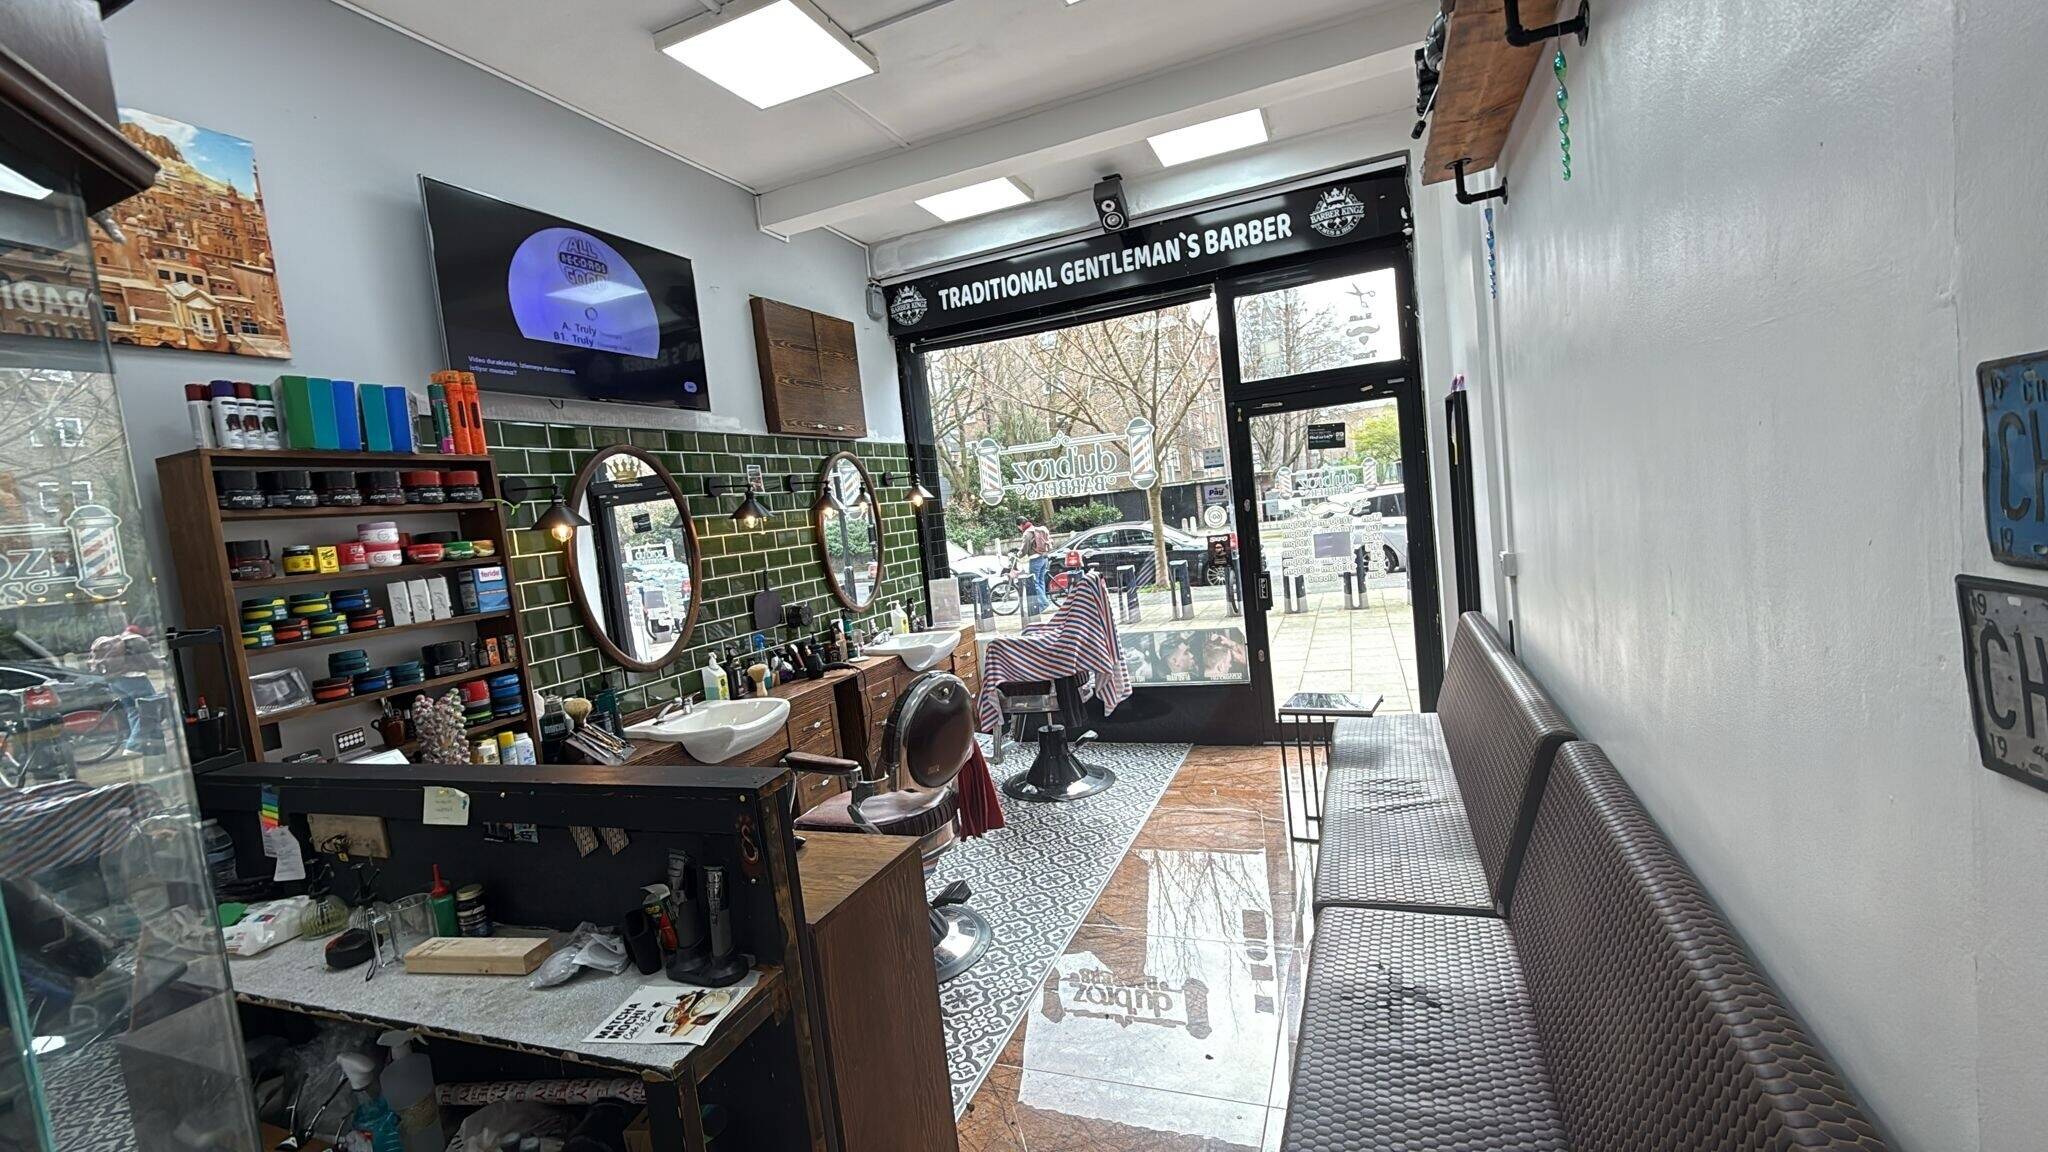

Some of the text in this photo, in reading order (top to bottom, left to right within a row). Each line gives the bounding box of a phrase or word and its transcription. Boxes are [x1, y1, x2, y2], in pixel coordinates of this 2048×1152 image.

[1310, 205, 1365, 224] BARBER KINGZ
[567, 239, 598, 259] ALL
[938, 266, 1057, 311] TRADITIONAL
[1205, 213, 1293, 255] BARBER
[575, 323, 597, 336] Truly
[572, 334, 594, 347] Truly
[594, 1002, 641, 1039] MATCHA
[608, 1010, 646, 1039] MOCHI
